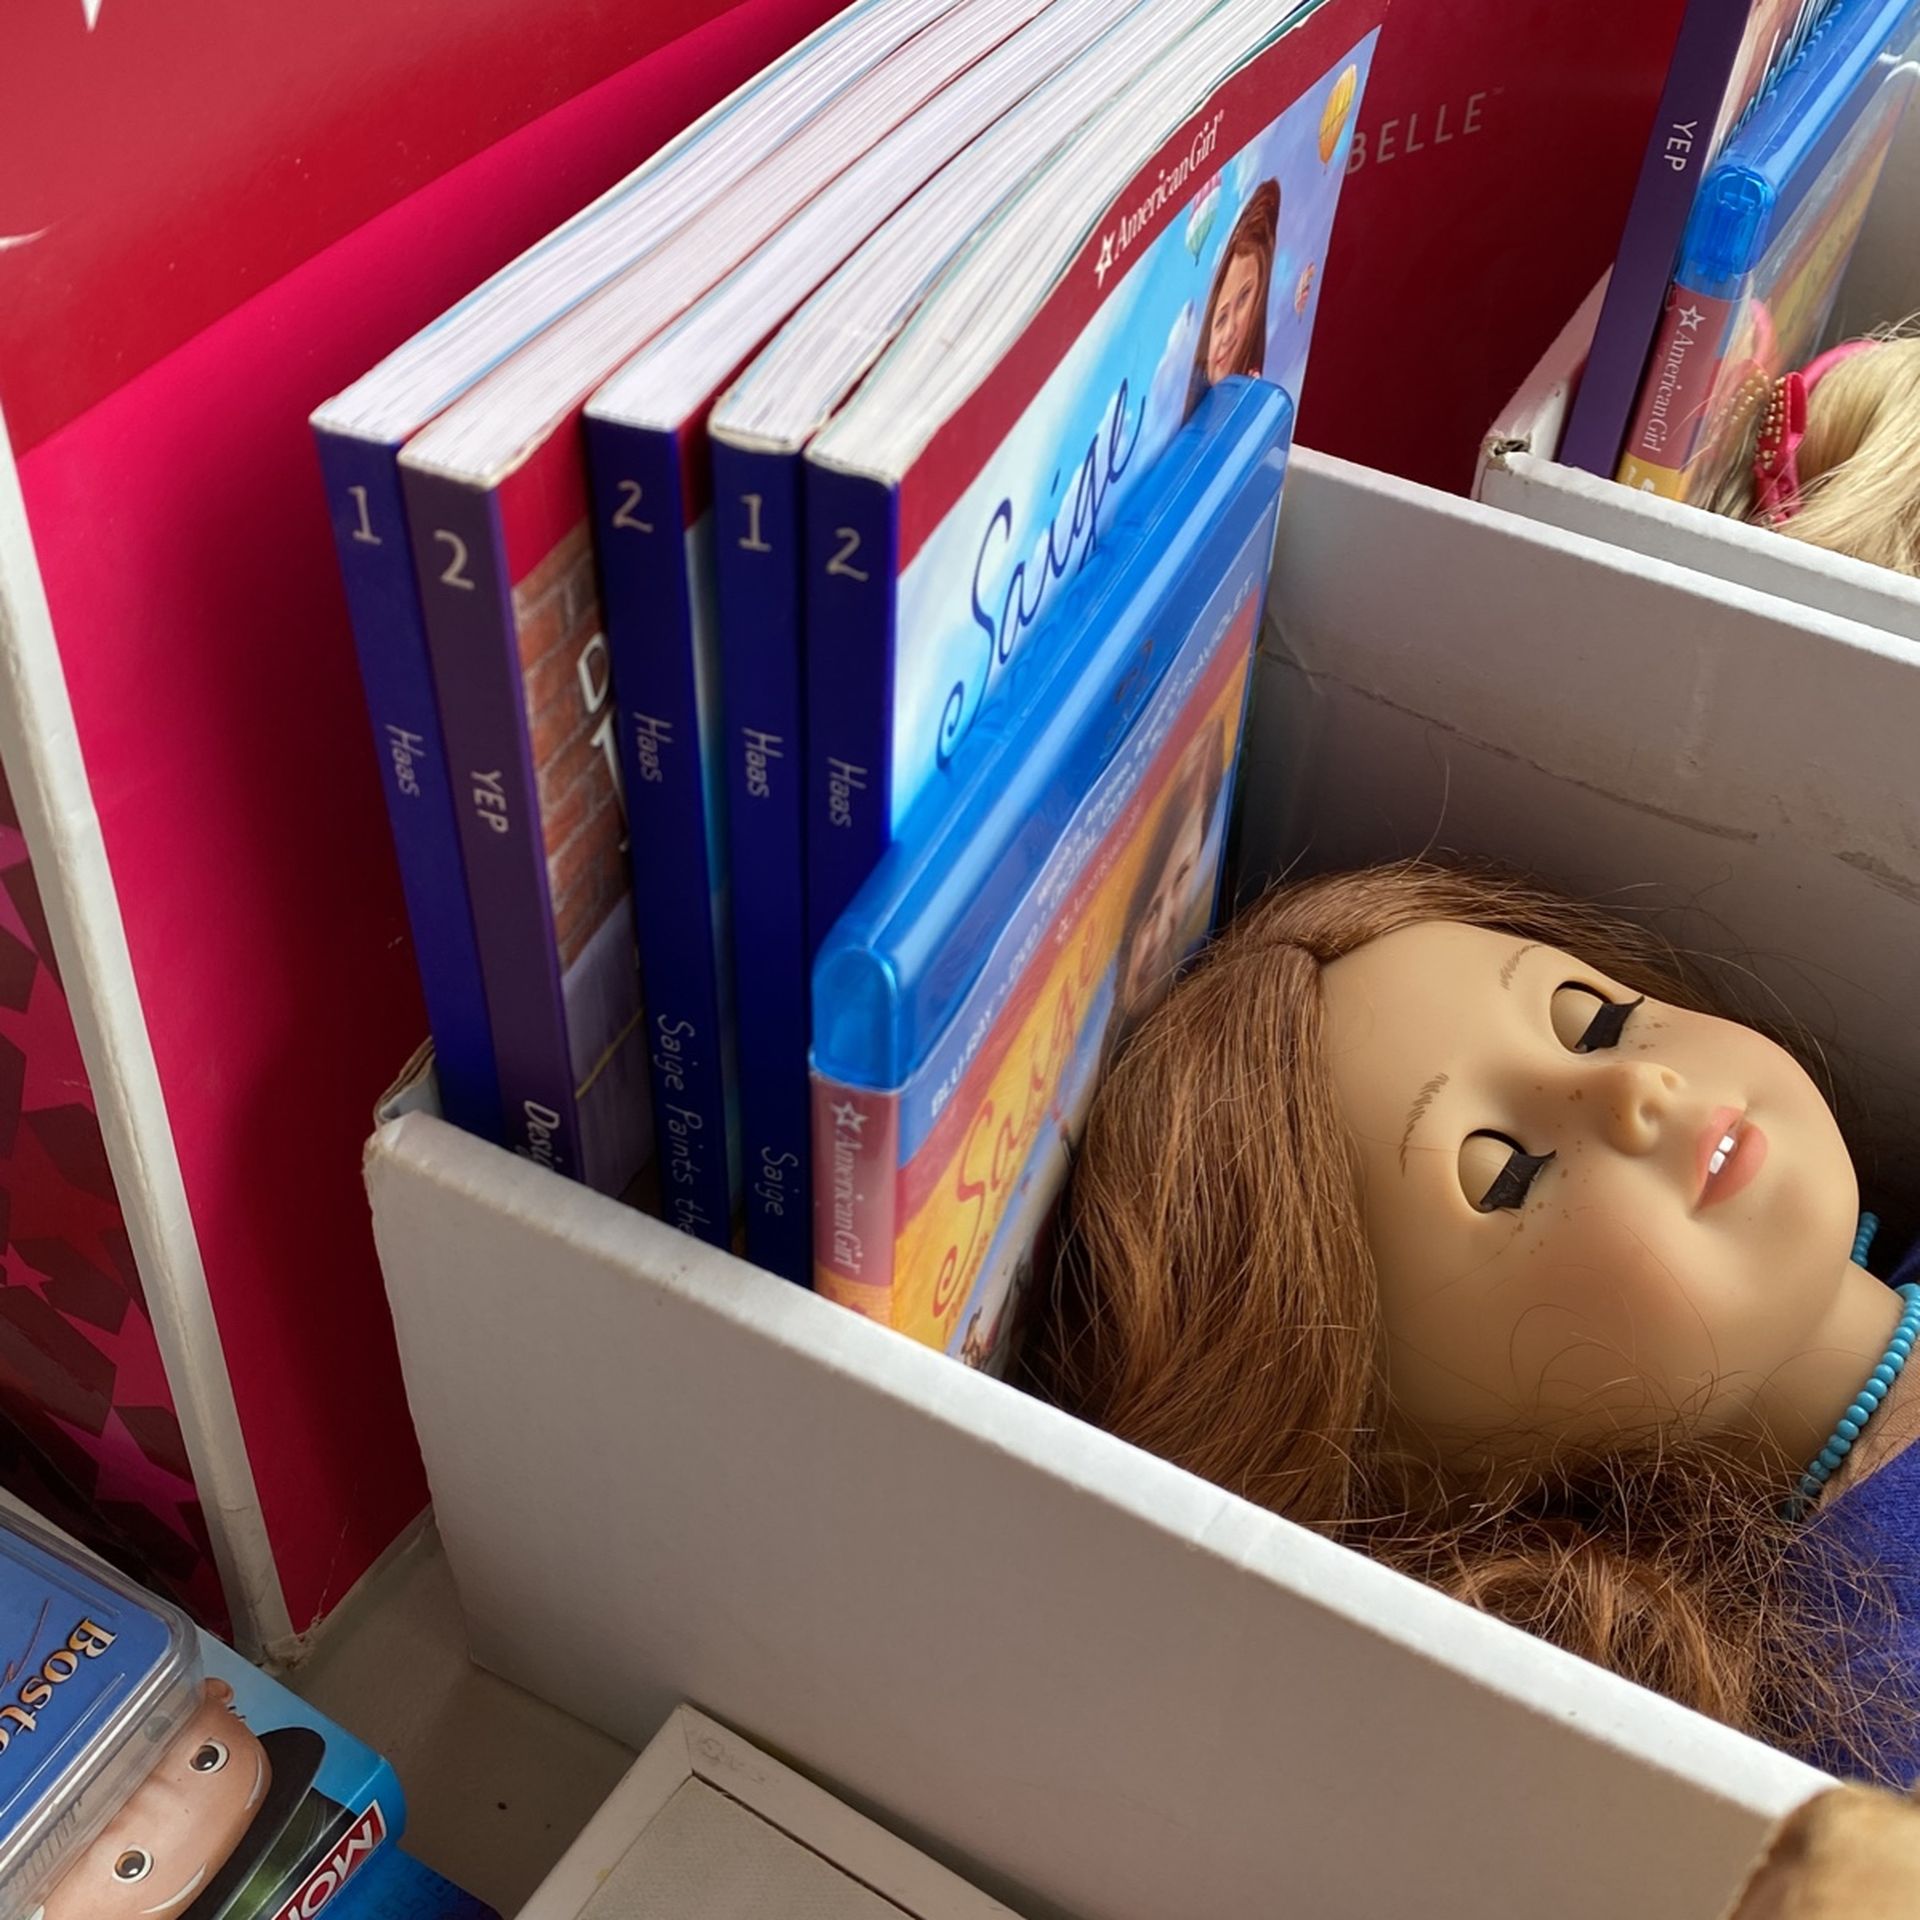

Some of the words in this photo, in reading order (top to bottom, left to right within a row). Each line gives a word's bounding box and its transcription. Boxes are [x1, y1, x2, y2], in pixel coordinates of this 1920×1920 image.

[1346, 92, 1487, 175] BELLE
[1664, 119, 1698, 172] YEP
[348, 486, 381, 544] 1
[613, 480, 653, 533] 2
[738, 495, 771, 552] 1
[434, 530, 474, 590] 2
[825, 528, 868, 582] 2
[936, 377, 1147, 770] Saige
[386, 723, 423, 797] Haas
[633, 712, 672, 783] Haas
[743, 728, 783, 798] Haas
[471, 770, 508, 833] YEP
[827, 757, 867, 828] Haas
[653, 1014, 699, 1091] Saige
[665, 1103, 704, 1185] Paints
[755, 1147, 800, 1216] Saige
[287, 1819, 374, 1920] MO
